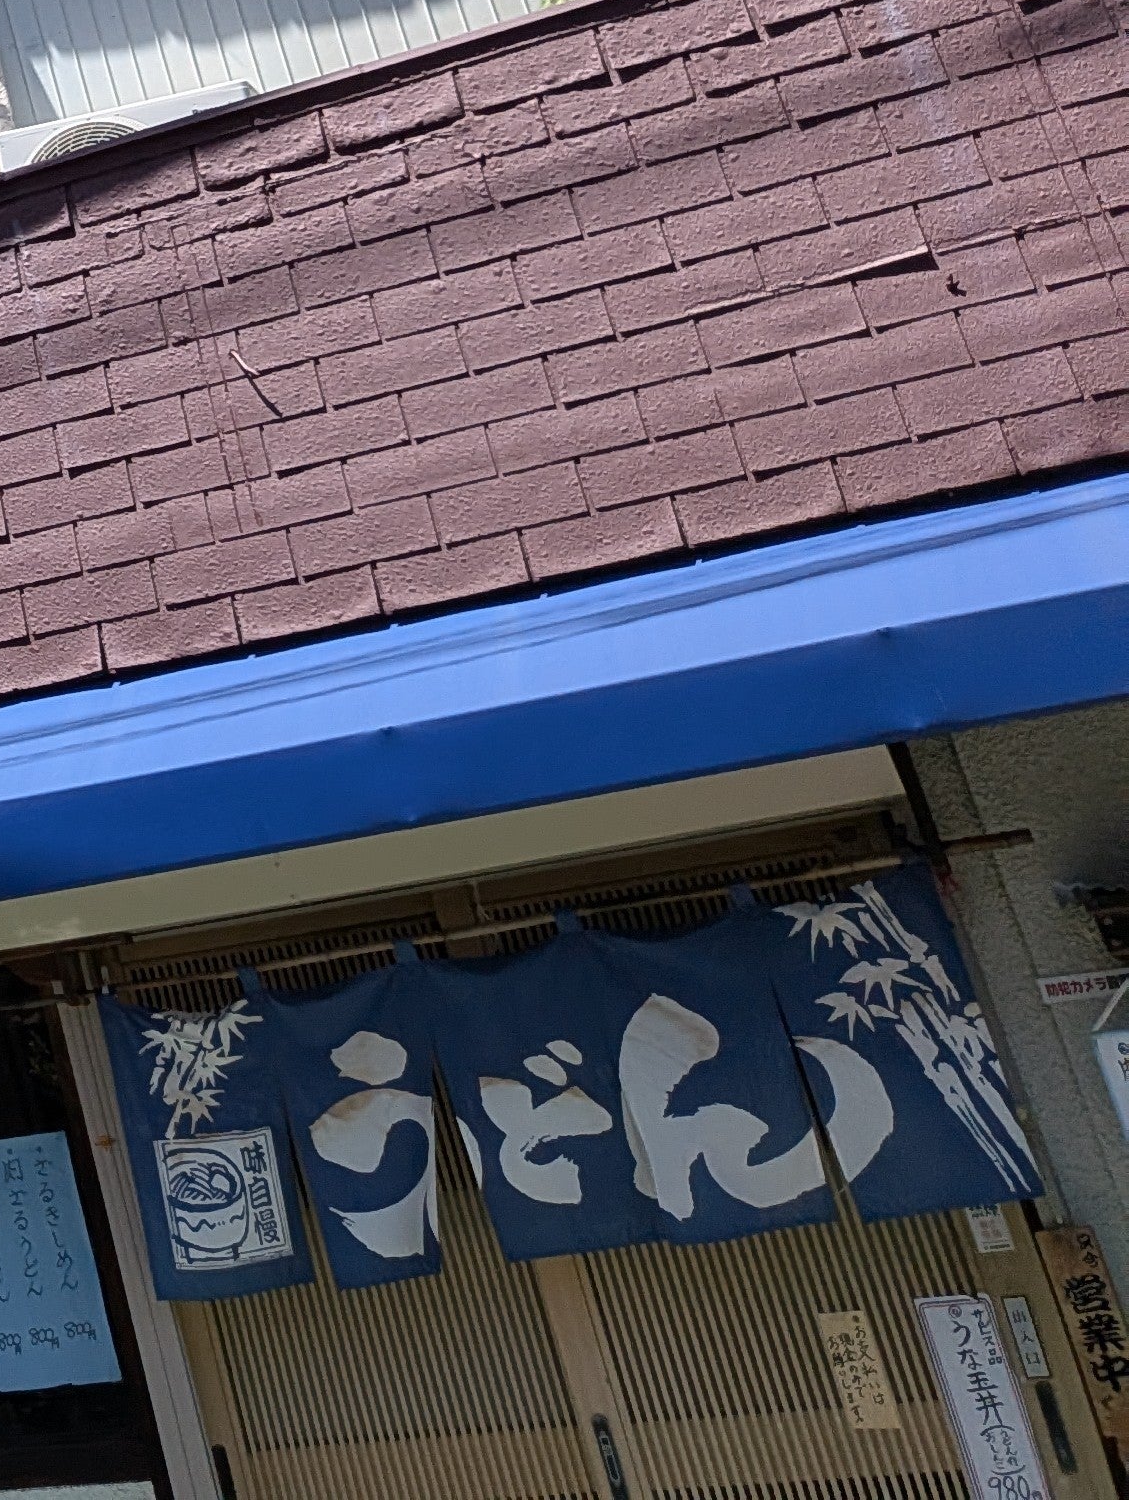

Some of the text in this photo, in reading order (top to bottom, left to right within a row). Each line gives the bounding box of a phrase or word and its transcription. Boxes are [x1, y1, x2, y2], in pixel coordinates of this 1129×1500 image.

[310, 992, 895, 1258] うどん
[240, 1140, 280, 1245] 味自慢
[1012, 1309, 1040, 1364] 出入口
[1064, 1273, 1129, 1393] 営業中
